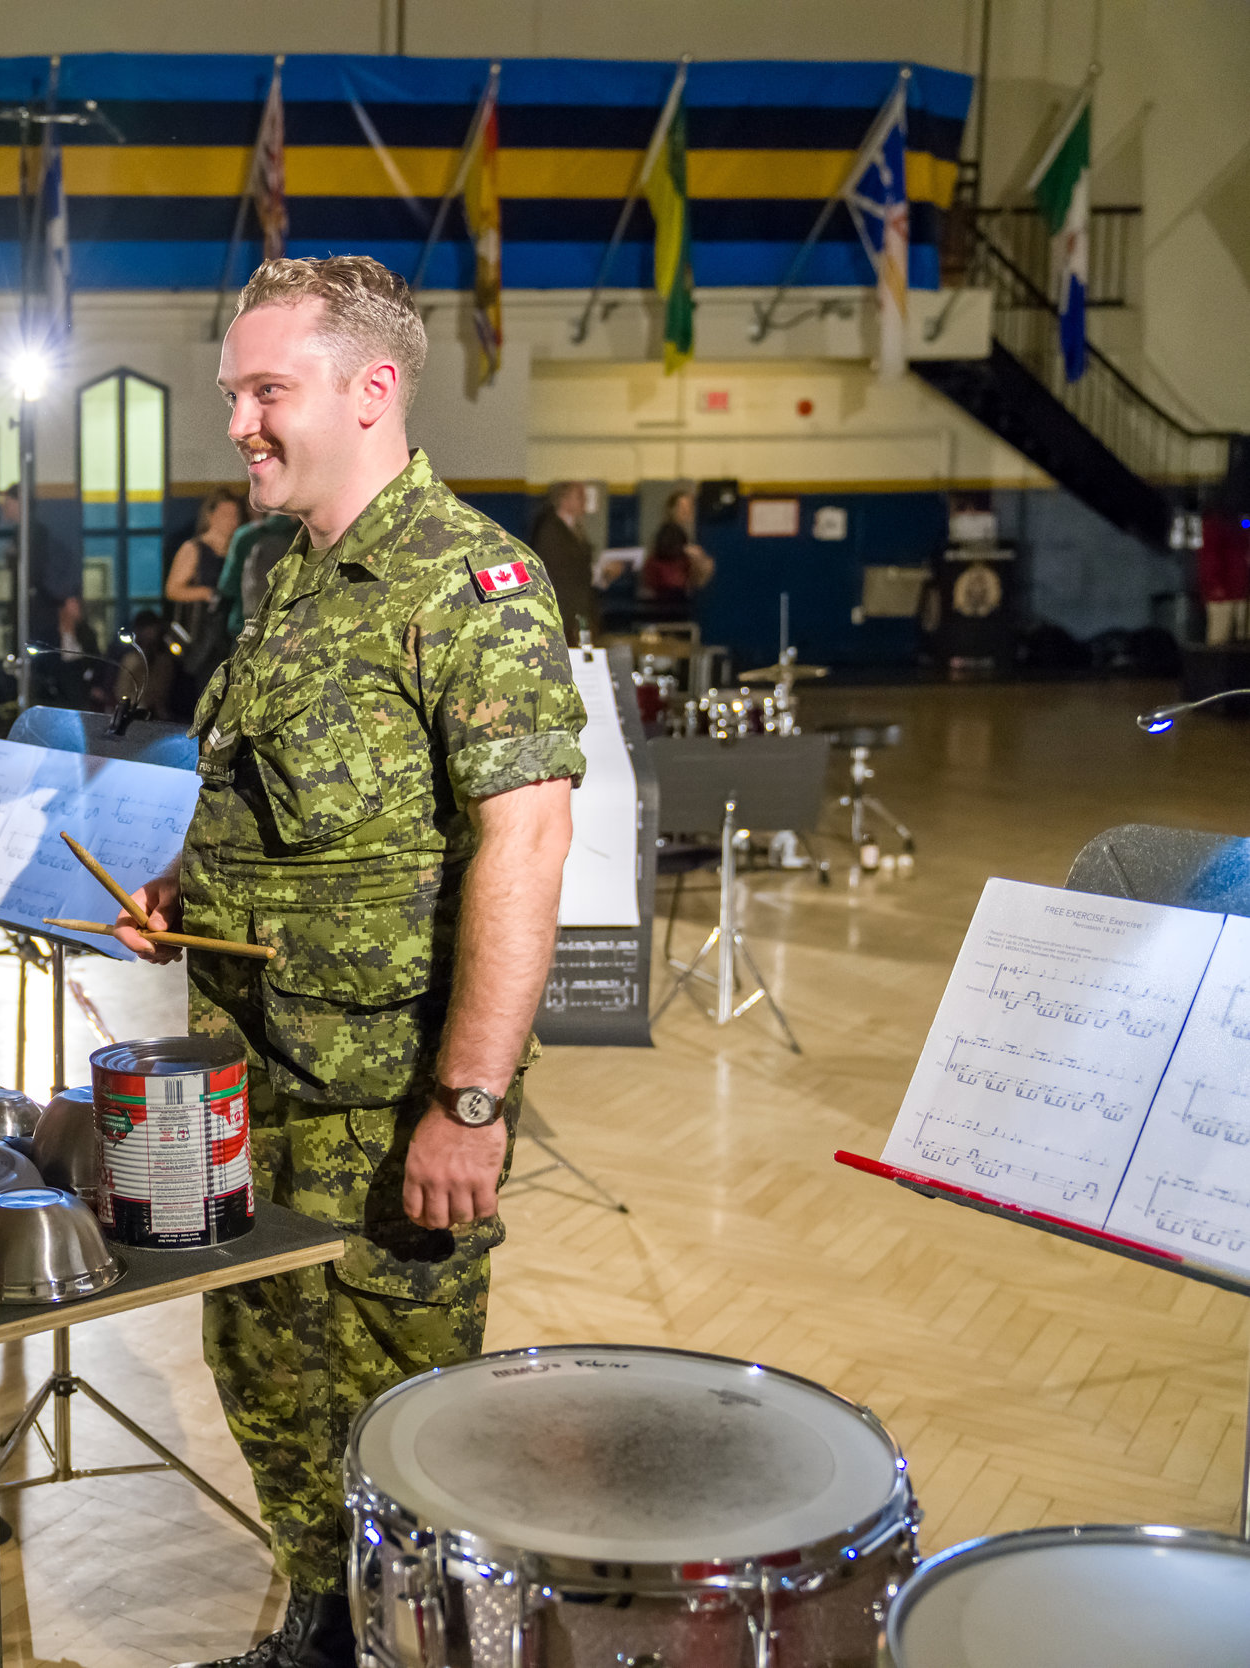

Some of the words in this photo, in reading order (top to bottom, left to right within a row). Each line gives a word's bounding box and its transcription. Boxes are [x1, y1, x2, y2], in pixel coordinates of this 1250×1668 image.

[199, 762, 211, 773] FUS
[1044, 905, 1064, 916] FREE
[1109, 916, 1142, 929] Exercise
[1072, 921, 1101, 931] Percussion
